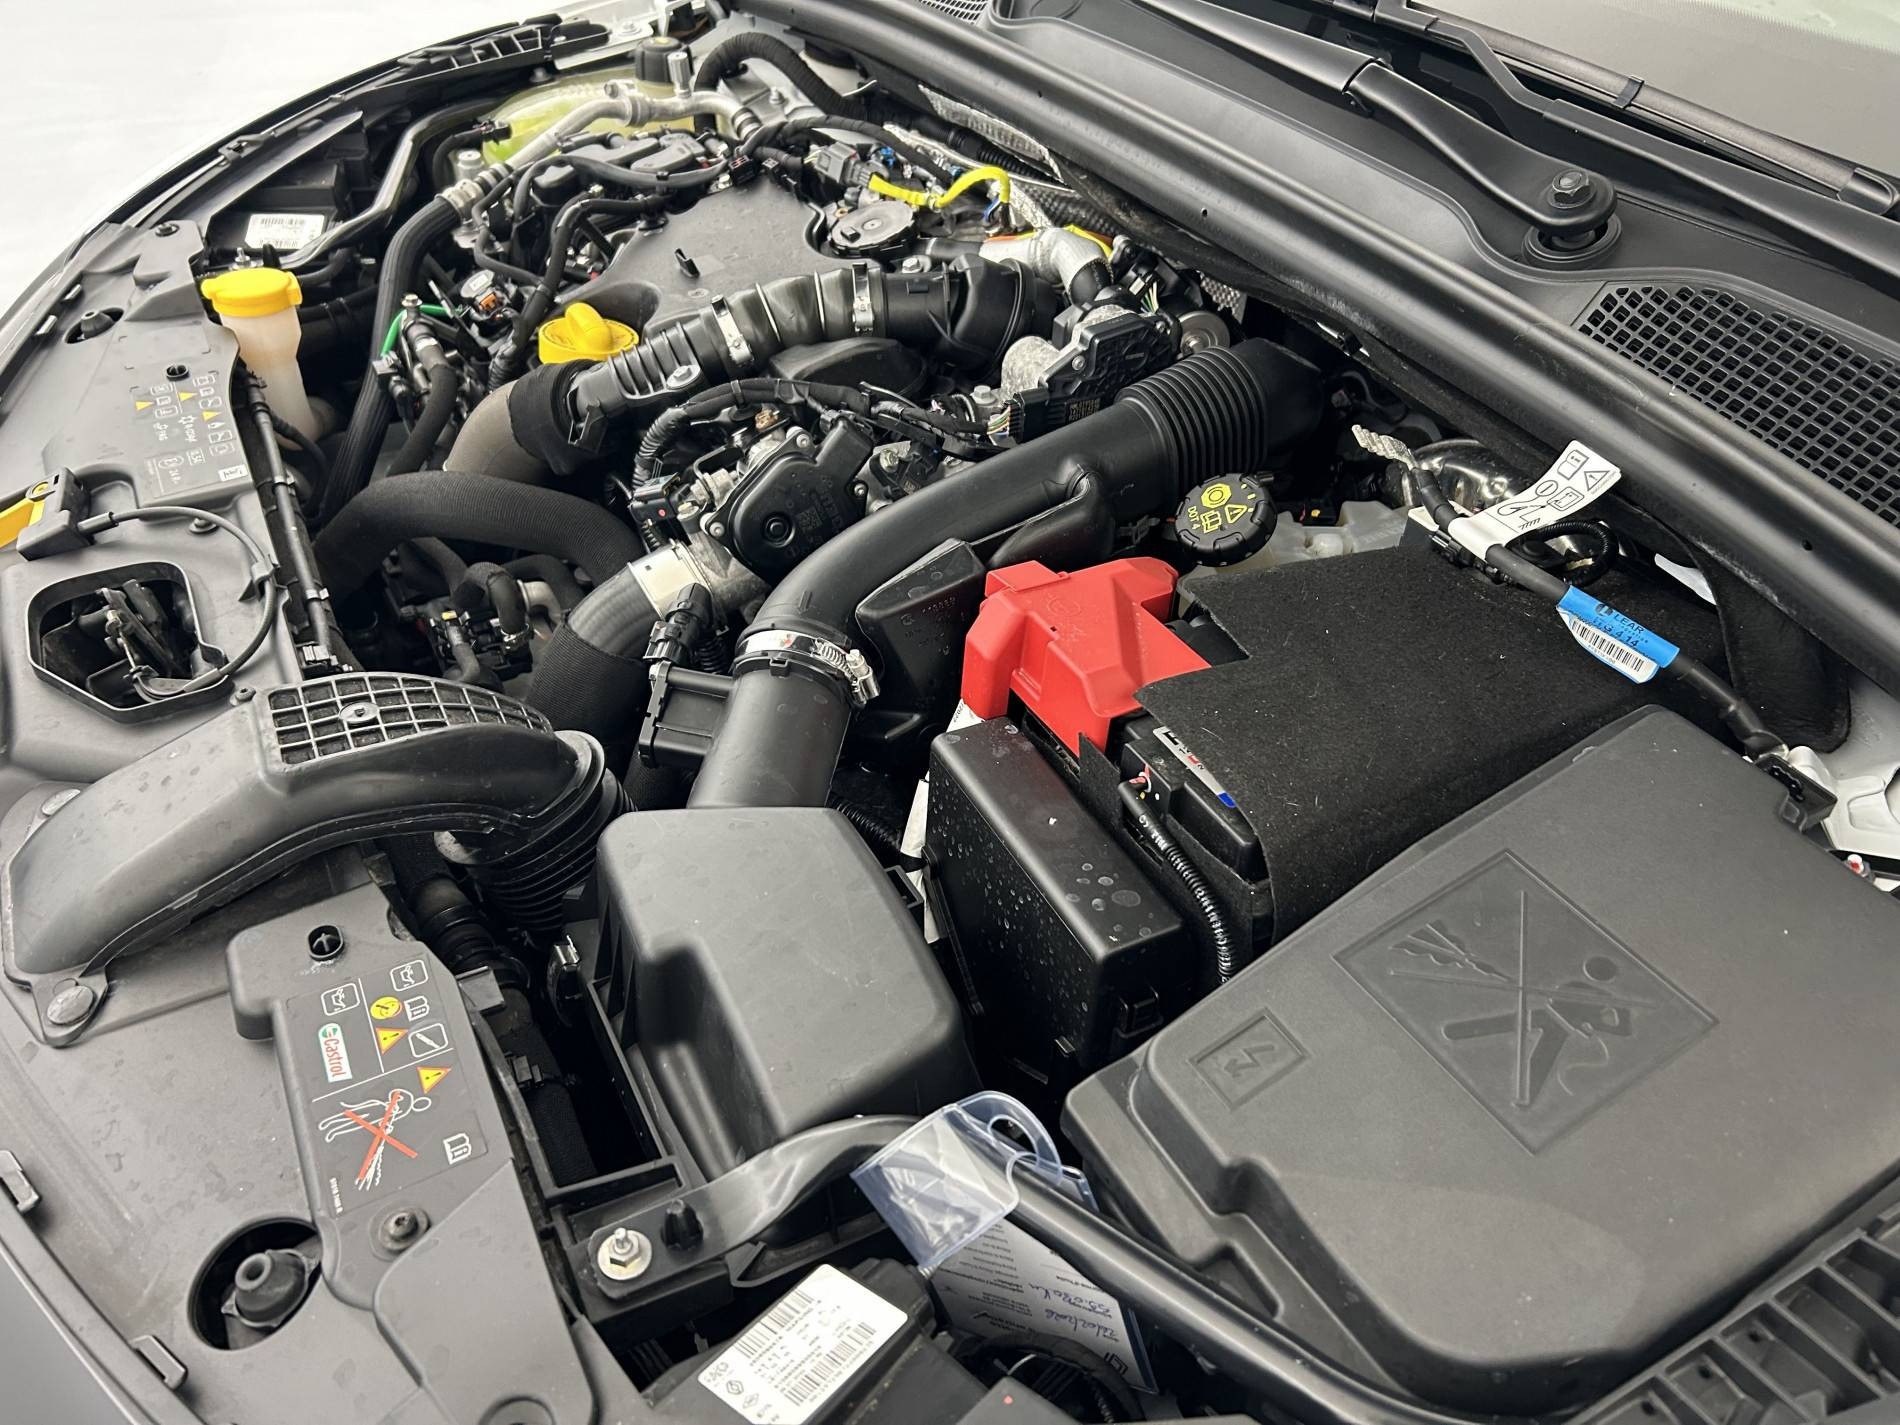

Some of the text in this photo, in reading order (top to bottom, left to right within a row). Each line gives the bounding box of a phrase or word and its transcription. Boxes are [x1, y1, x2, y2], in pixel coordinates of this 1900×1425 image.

[1187, 505, 1199, 522] DOT
[1613, 613, 1645, 635] LEAR
[323, 1038, 347, 1078] Castrol
